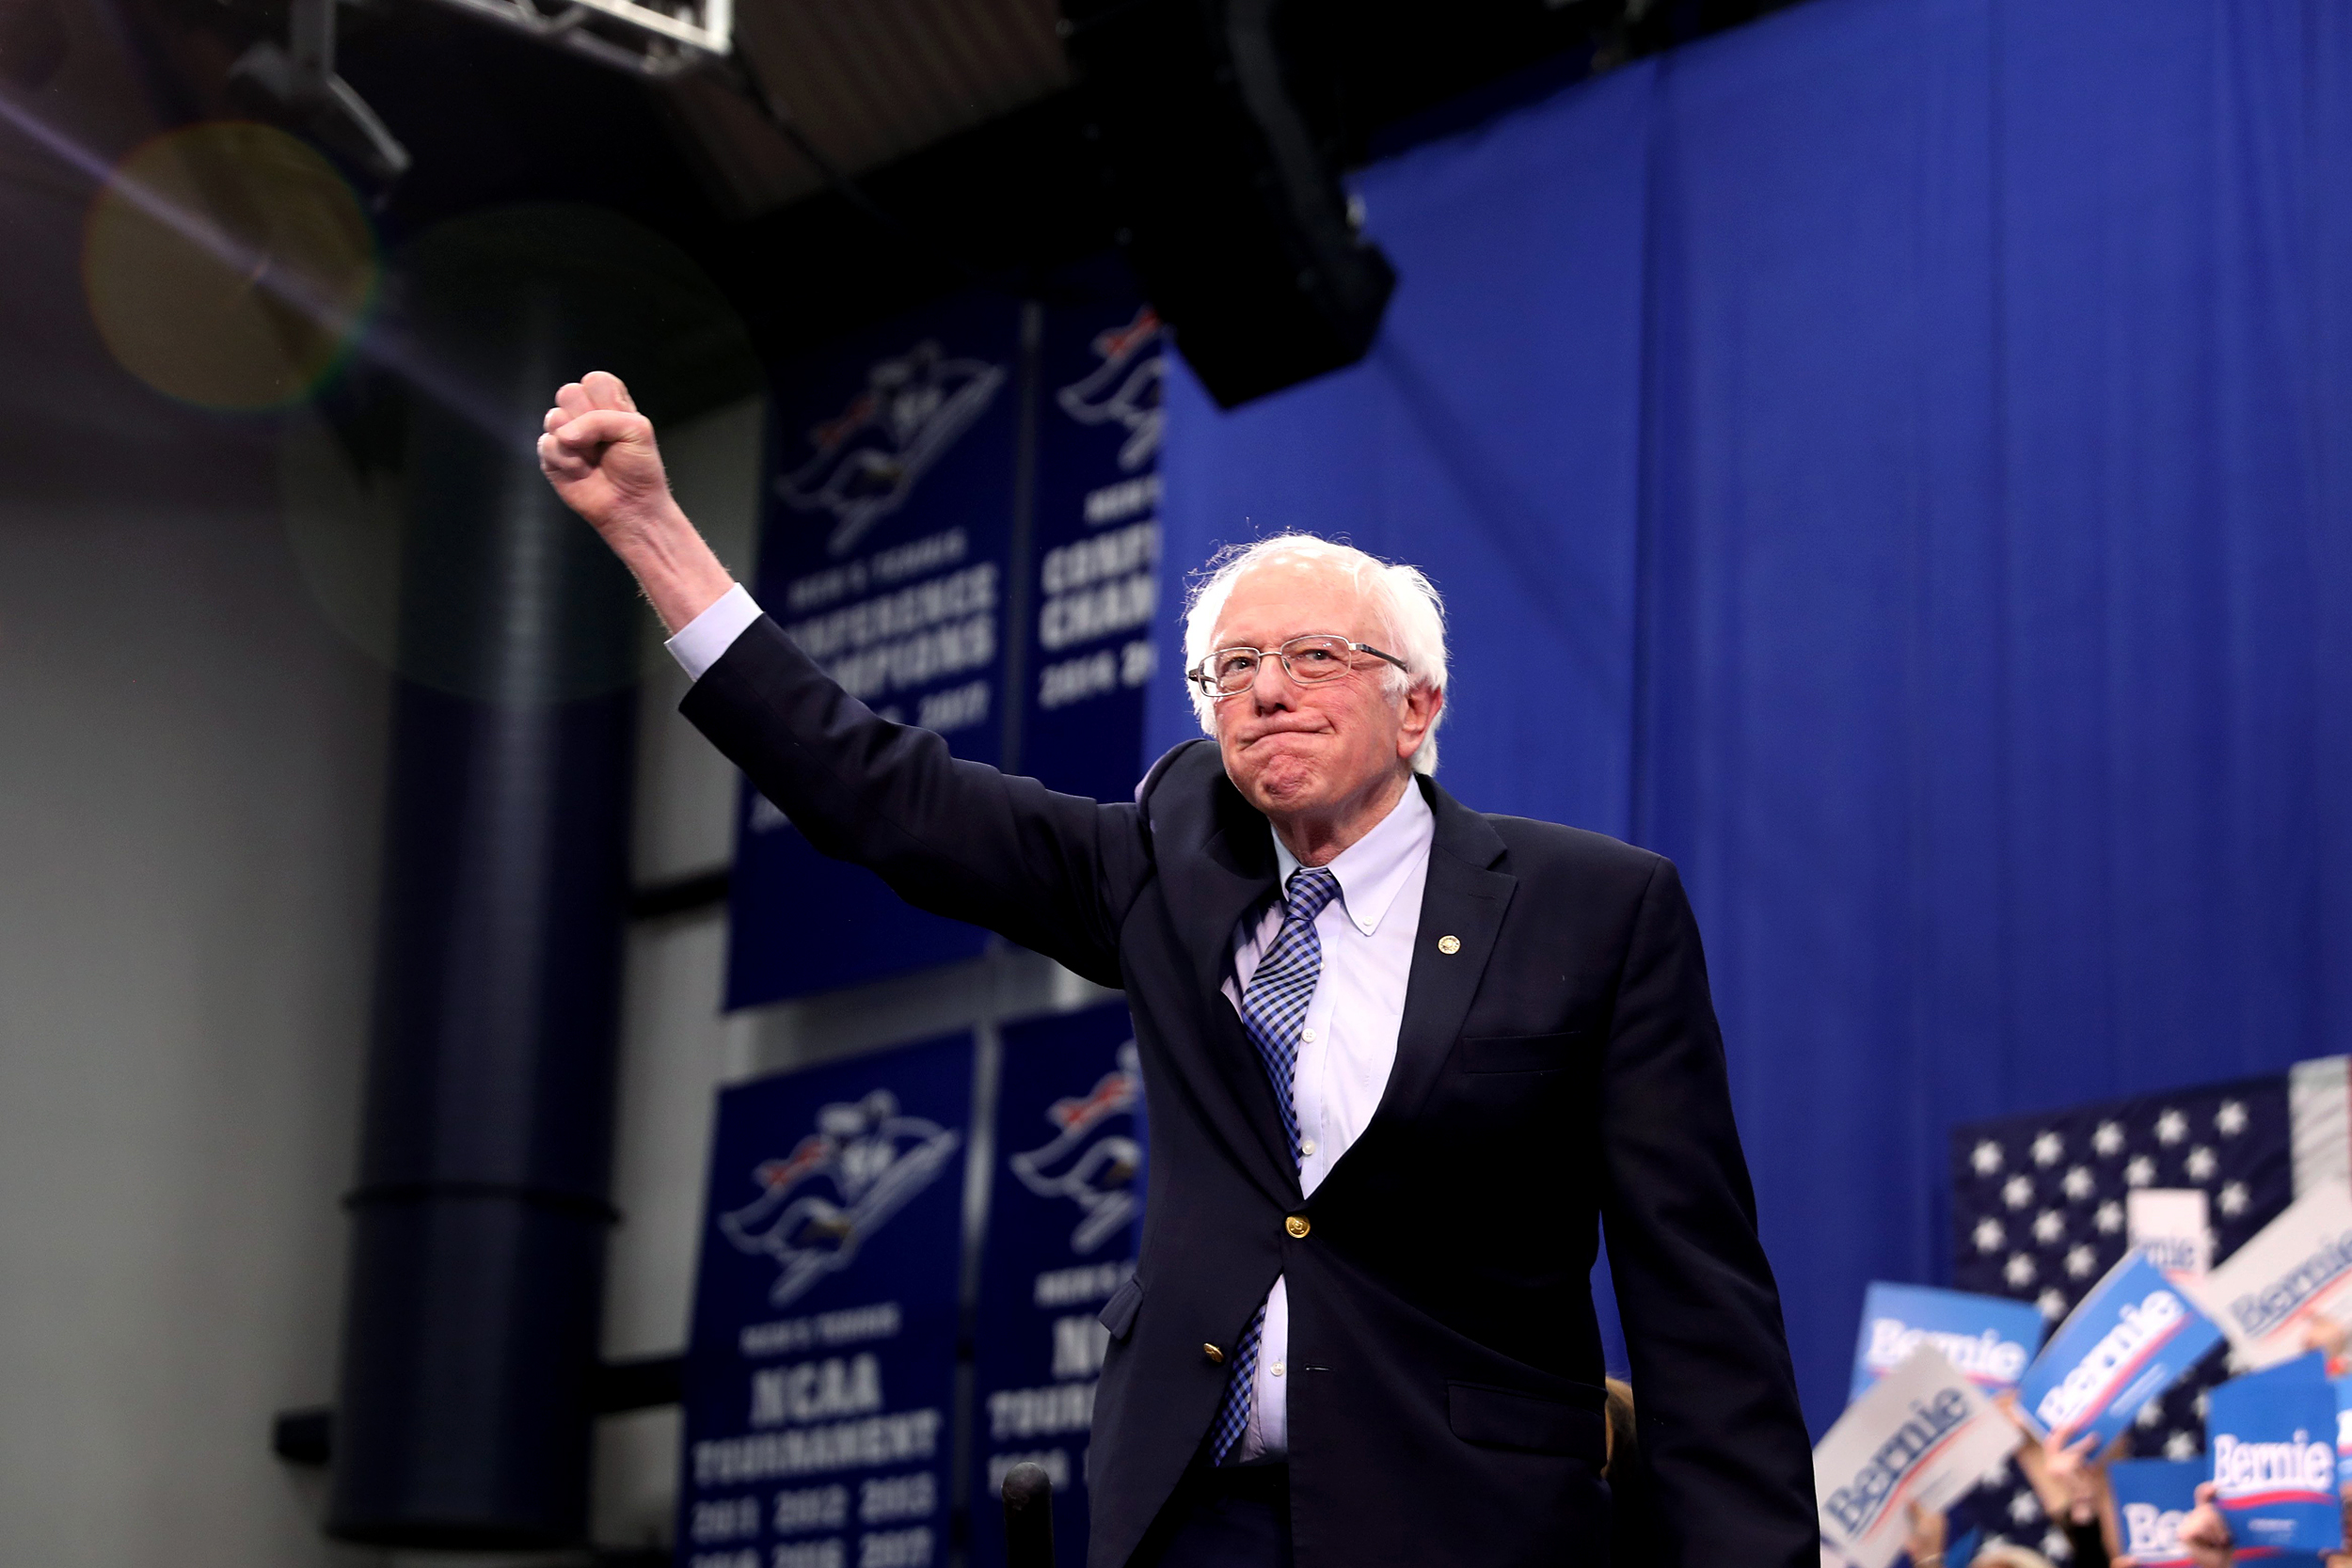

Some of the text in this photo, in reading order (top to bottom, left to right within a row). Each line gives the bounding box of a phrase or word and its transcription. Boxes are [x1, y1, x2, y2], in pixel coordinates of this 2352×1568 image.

[2036, 1290, 2184, 1425] Bernie
[1825, 1386, 1967, 1532] Bernie
[2214, 1429, 2335, 1490] Bernie
